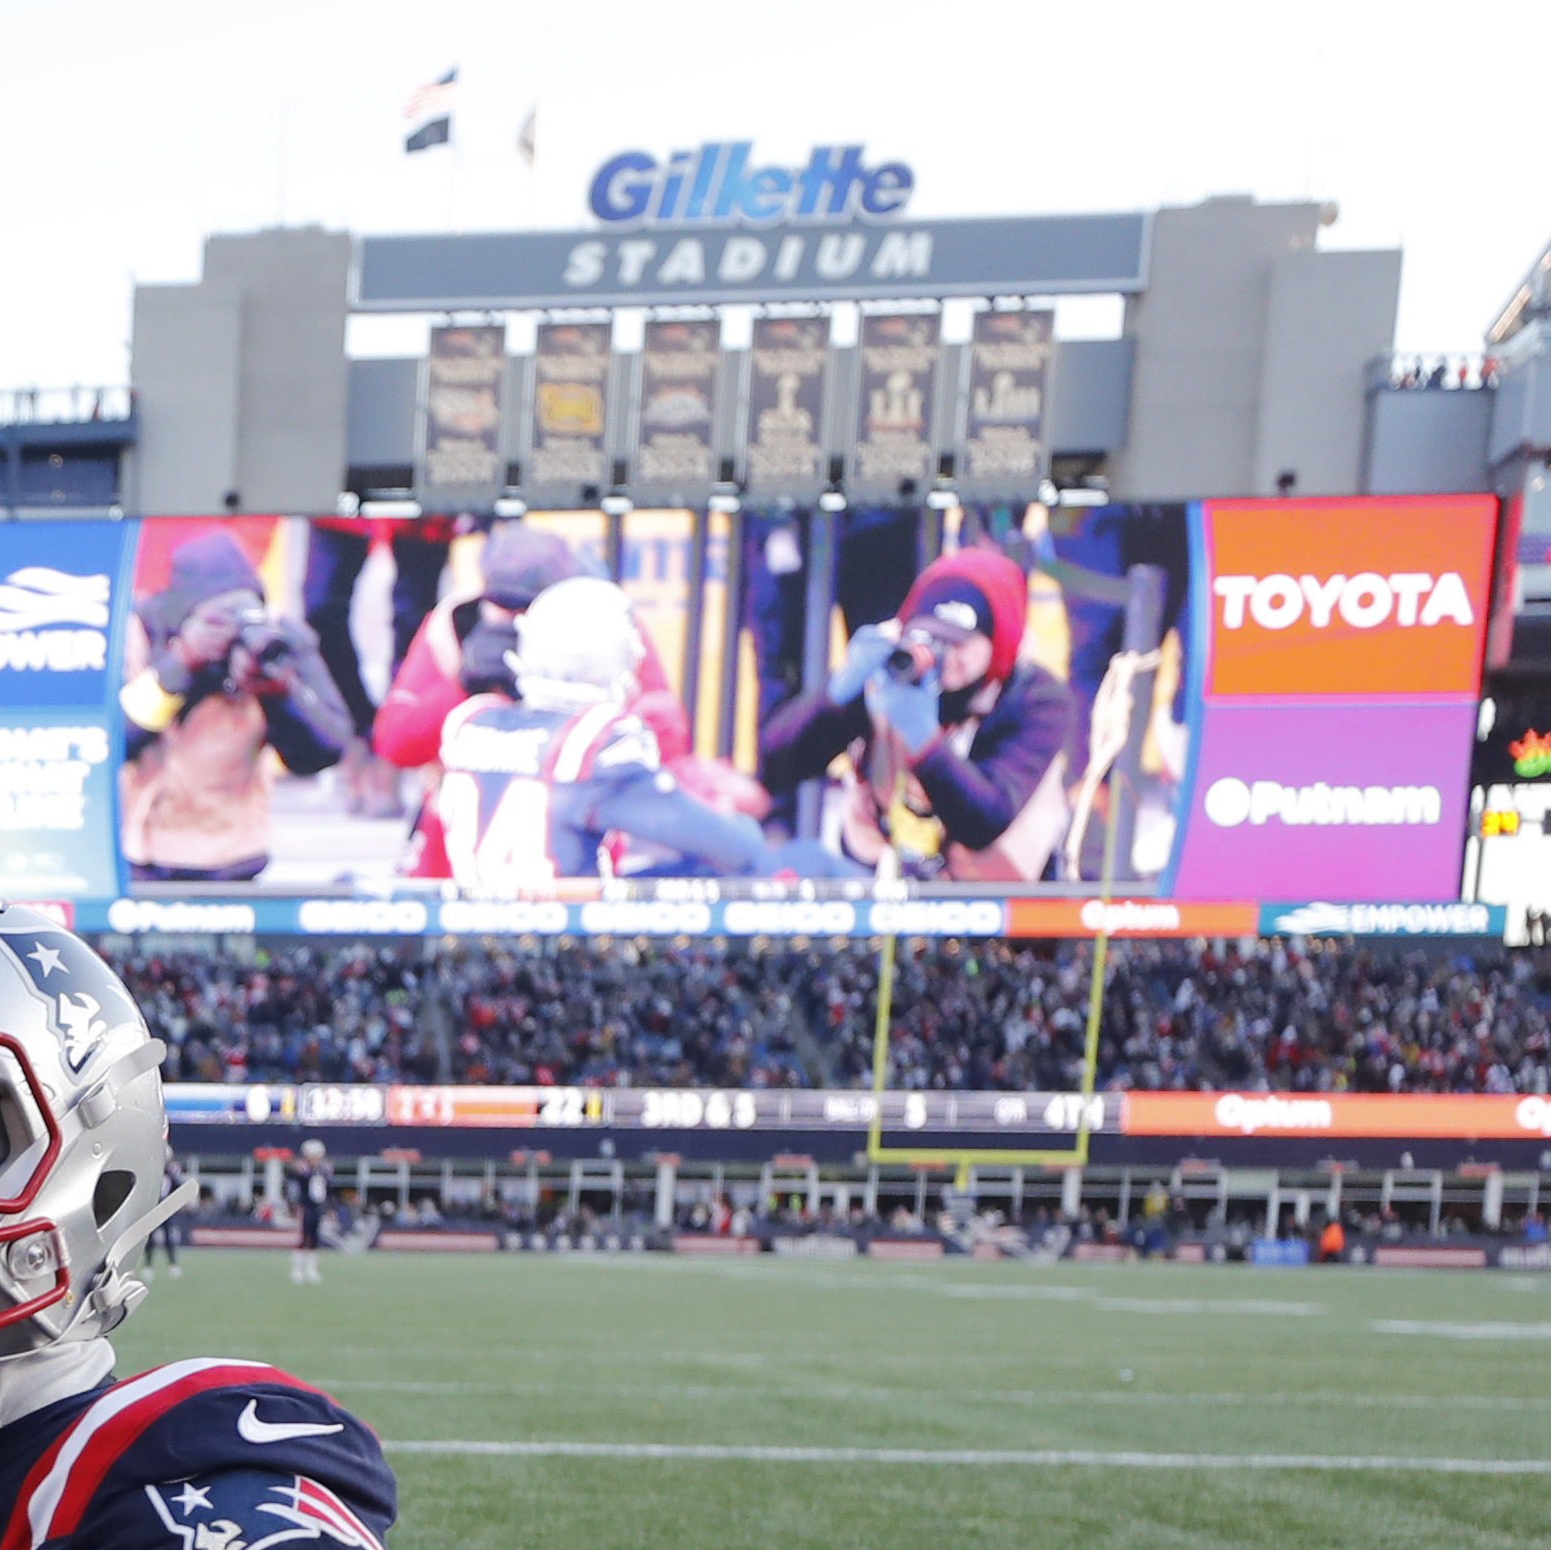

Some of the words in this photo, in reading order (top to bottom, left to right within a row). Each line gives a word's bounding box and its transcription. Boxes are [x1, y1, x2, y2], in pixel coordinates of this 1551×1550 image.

[587, 140, 915, 226] Gillette
[562, 231, 934, 287] STADIUM
[1213, 572, 1475, 630] TOYOTA
[1249, 781, 1443, 826] Putnam
[539, 1087, 585, 1126] 22
[1213, 1092, 1333, 1134] Optum
